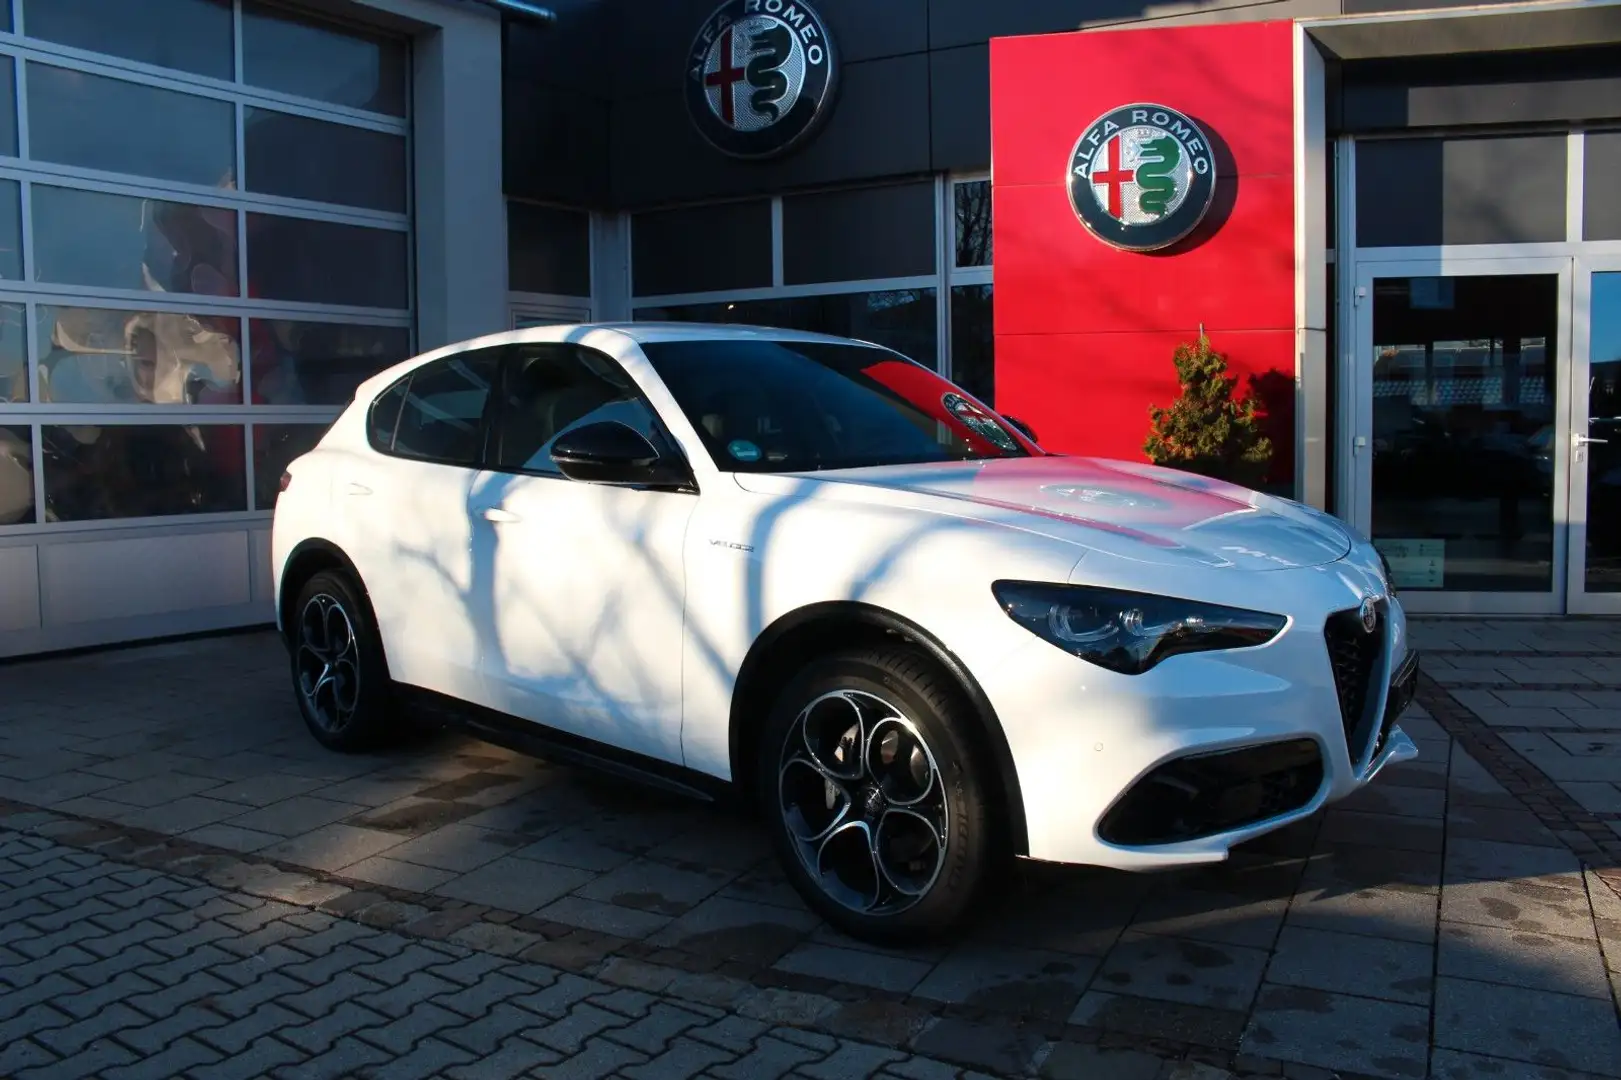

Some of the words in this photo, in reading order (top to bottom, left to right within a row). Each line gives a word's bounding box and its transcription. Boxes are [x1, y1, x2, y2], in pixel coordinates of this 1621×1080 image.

[689, 14, 732, 82] ALFA
[744, 0, 823, 65] ROMEO
[1073, 120, 1120, 179] ALFA
[1131, 110, 1209, 175] ROMEO
